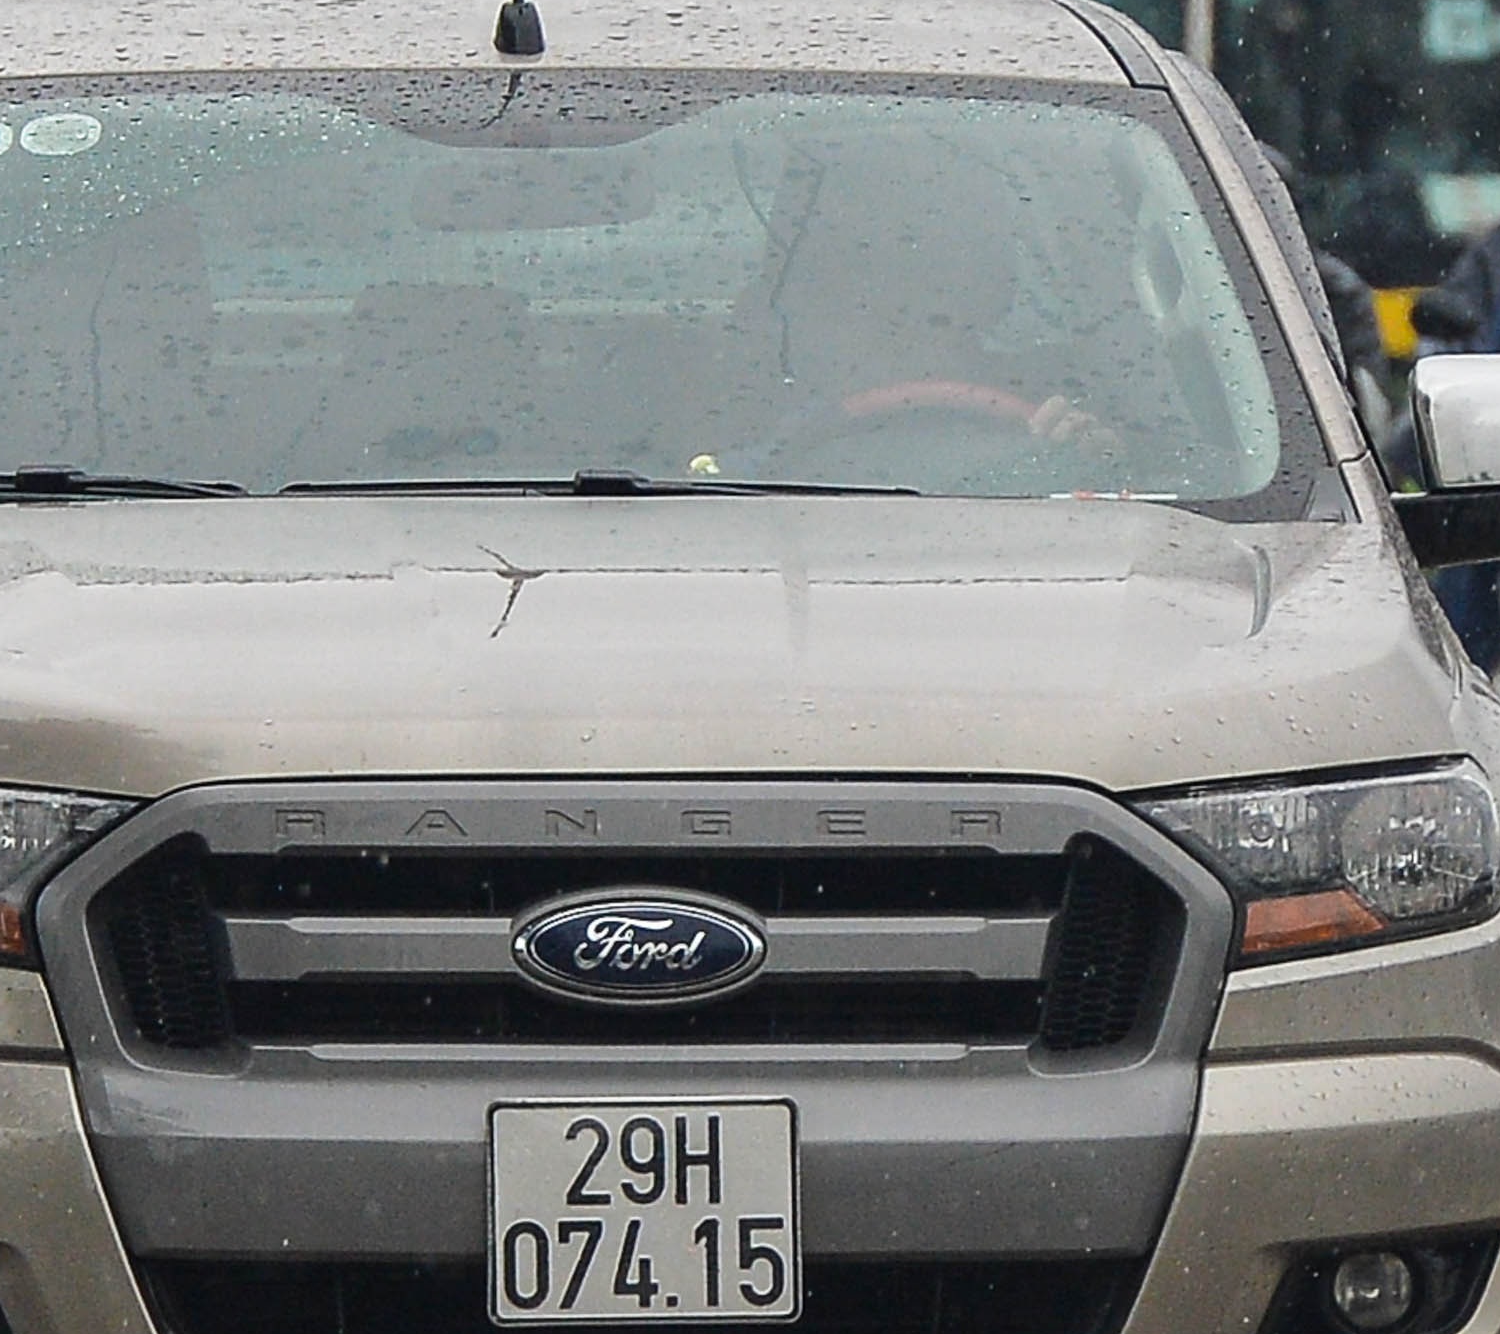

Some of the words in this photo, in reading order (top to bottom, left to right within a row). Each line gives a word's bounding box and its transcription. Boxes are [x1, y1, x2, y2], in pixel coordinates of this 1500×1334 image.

[275, 808, 1001, 838] RANGER
[573, 916, 706, 969] Ford
[565, 1115, 722, 1206] 29H
[503, 1217, 785, 1310] 074.15
